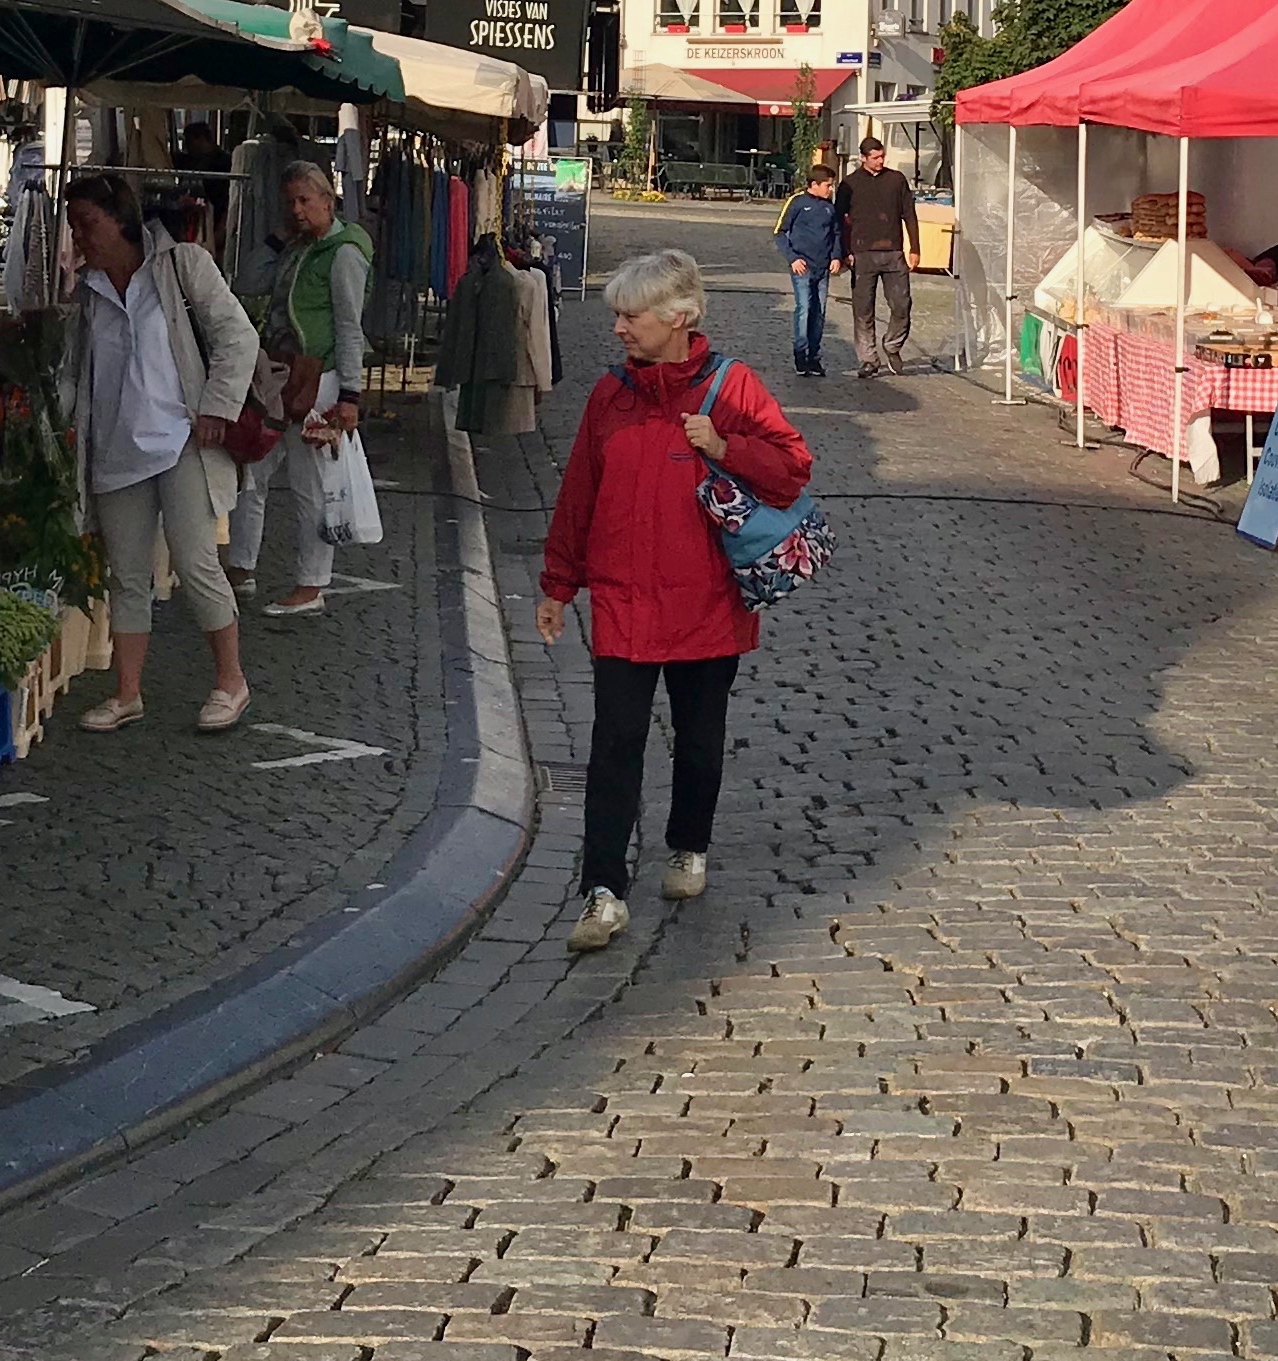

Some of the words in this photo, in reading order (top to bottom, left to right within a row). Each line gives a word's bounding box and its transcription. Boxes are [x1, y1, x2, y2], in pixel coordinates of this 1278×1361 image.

[485, 0, 522, 19] VISJES
[525, 1, 548, 20] VAN
[469, 20, 555, 50] SPIESSENS
[687, 48, 700, 58] DE
[704, 48, 785, 58] KEIZERSKROON
